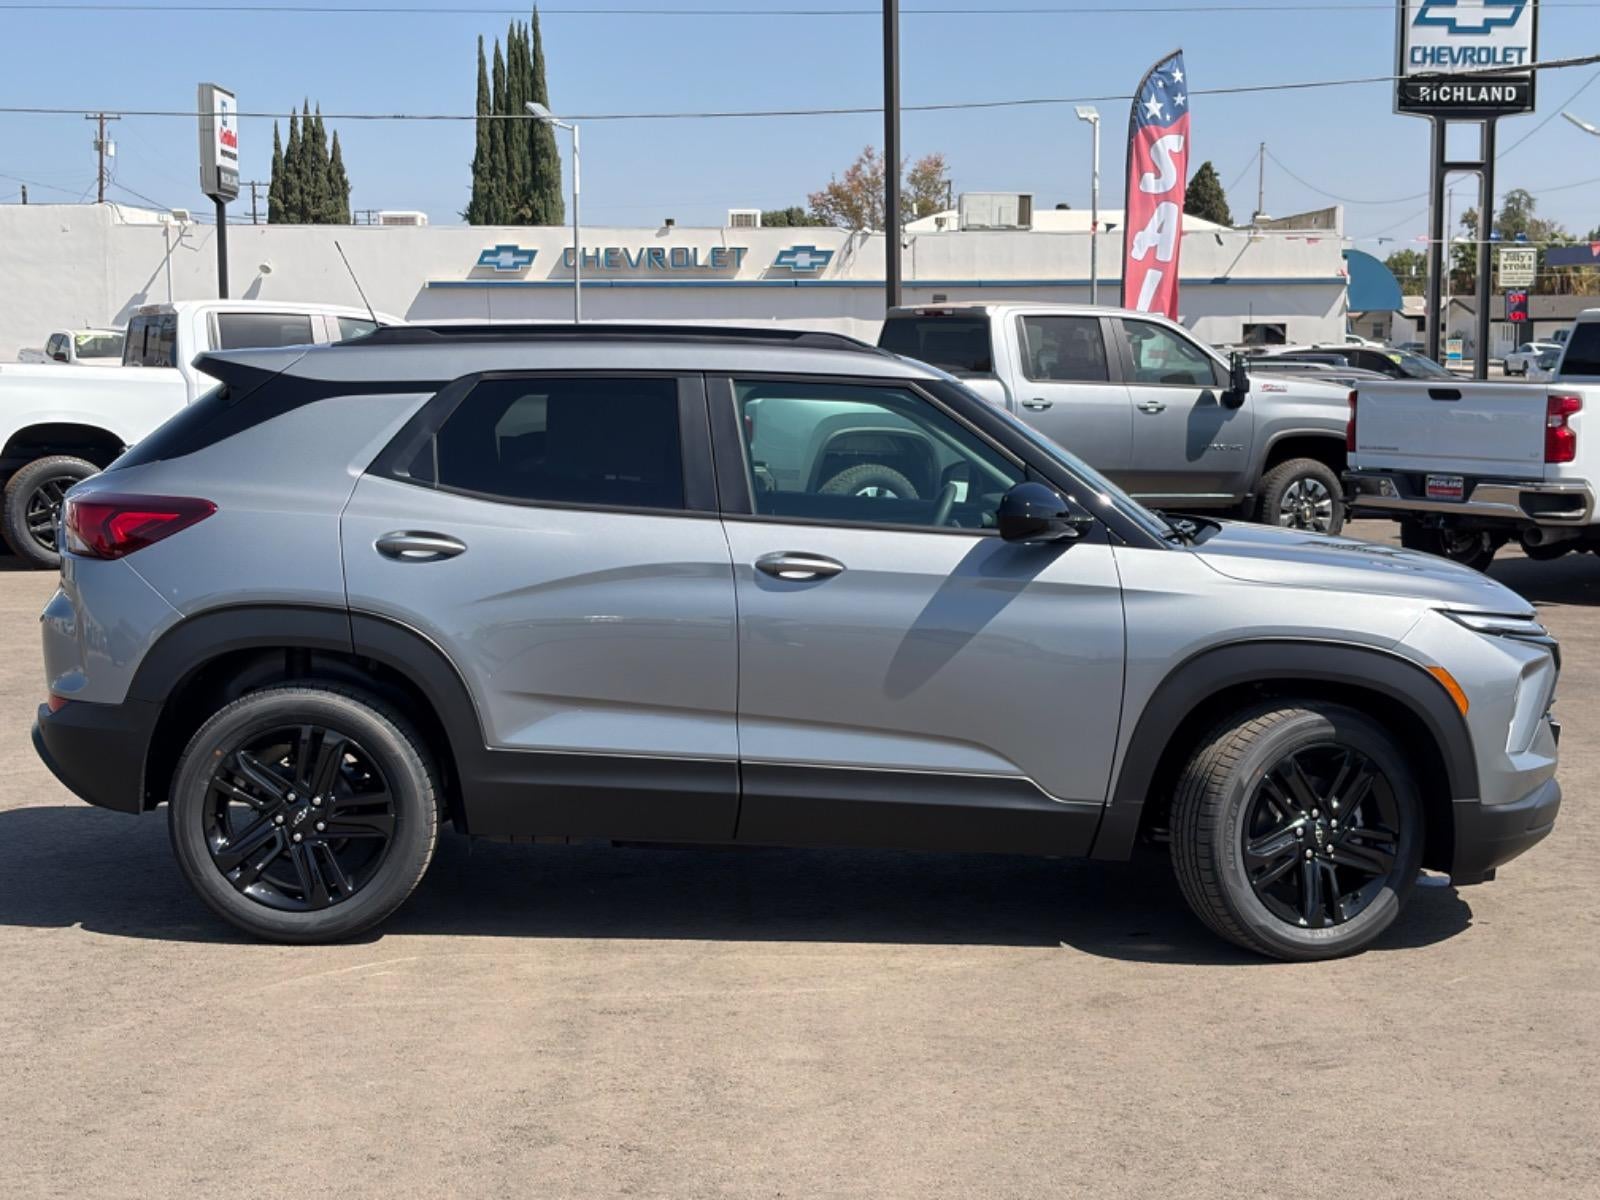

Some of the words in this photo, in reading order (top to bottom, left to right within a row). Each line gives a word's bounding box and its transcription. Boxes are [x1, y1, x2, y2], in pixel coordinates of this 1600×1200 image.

[1410, 46, 1528, 65] CHEVROLET
[1419, 86, 1517, 101] RICHLAND
[562, 247, 748, 269] CHEVROLET
[1503, 263, 1533, 271] STORE
